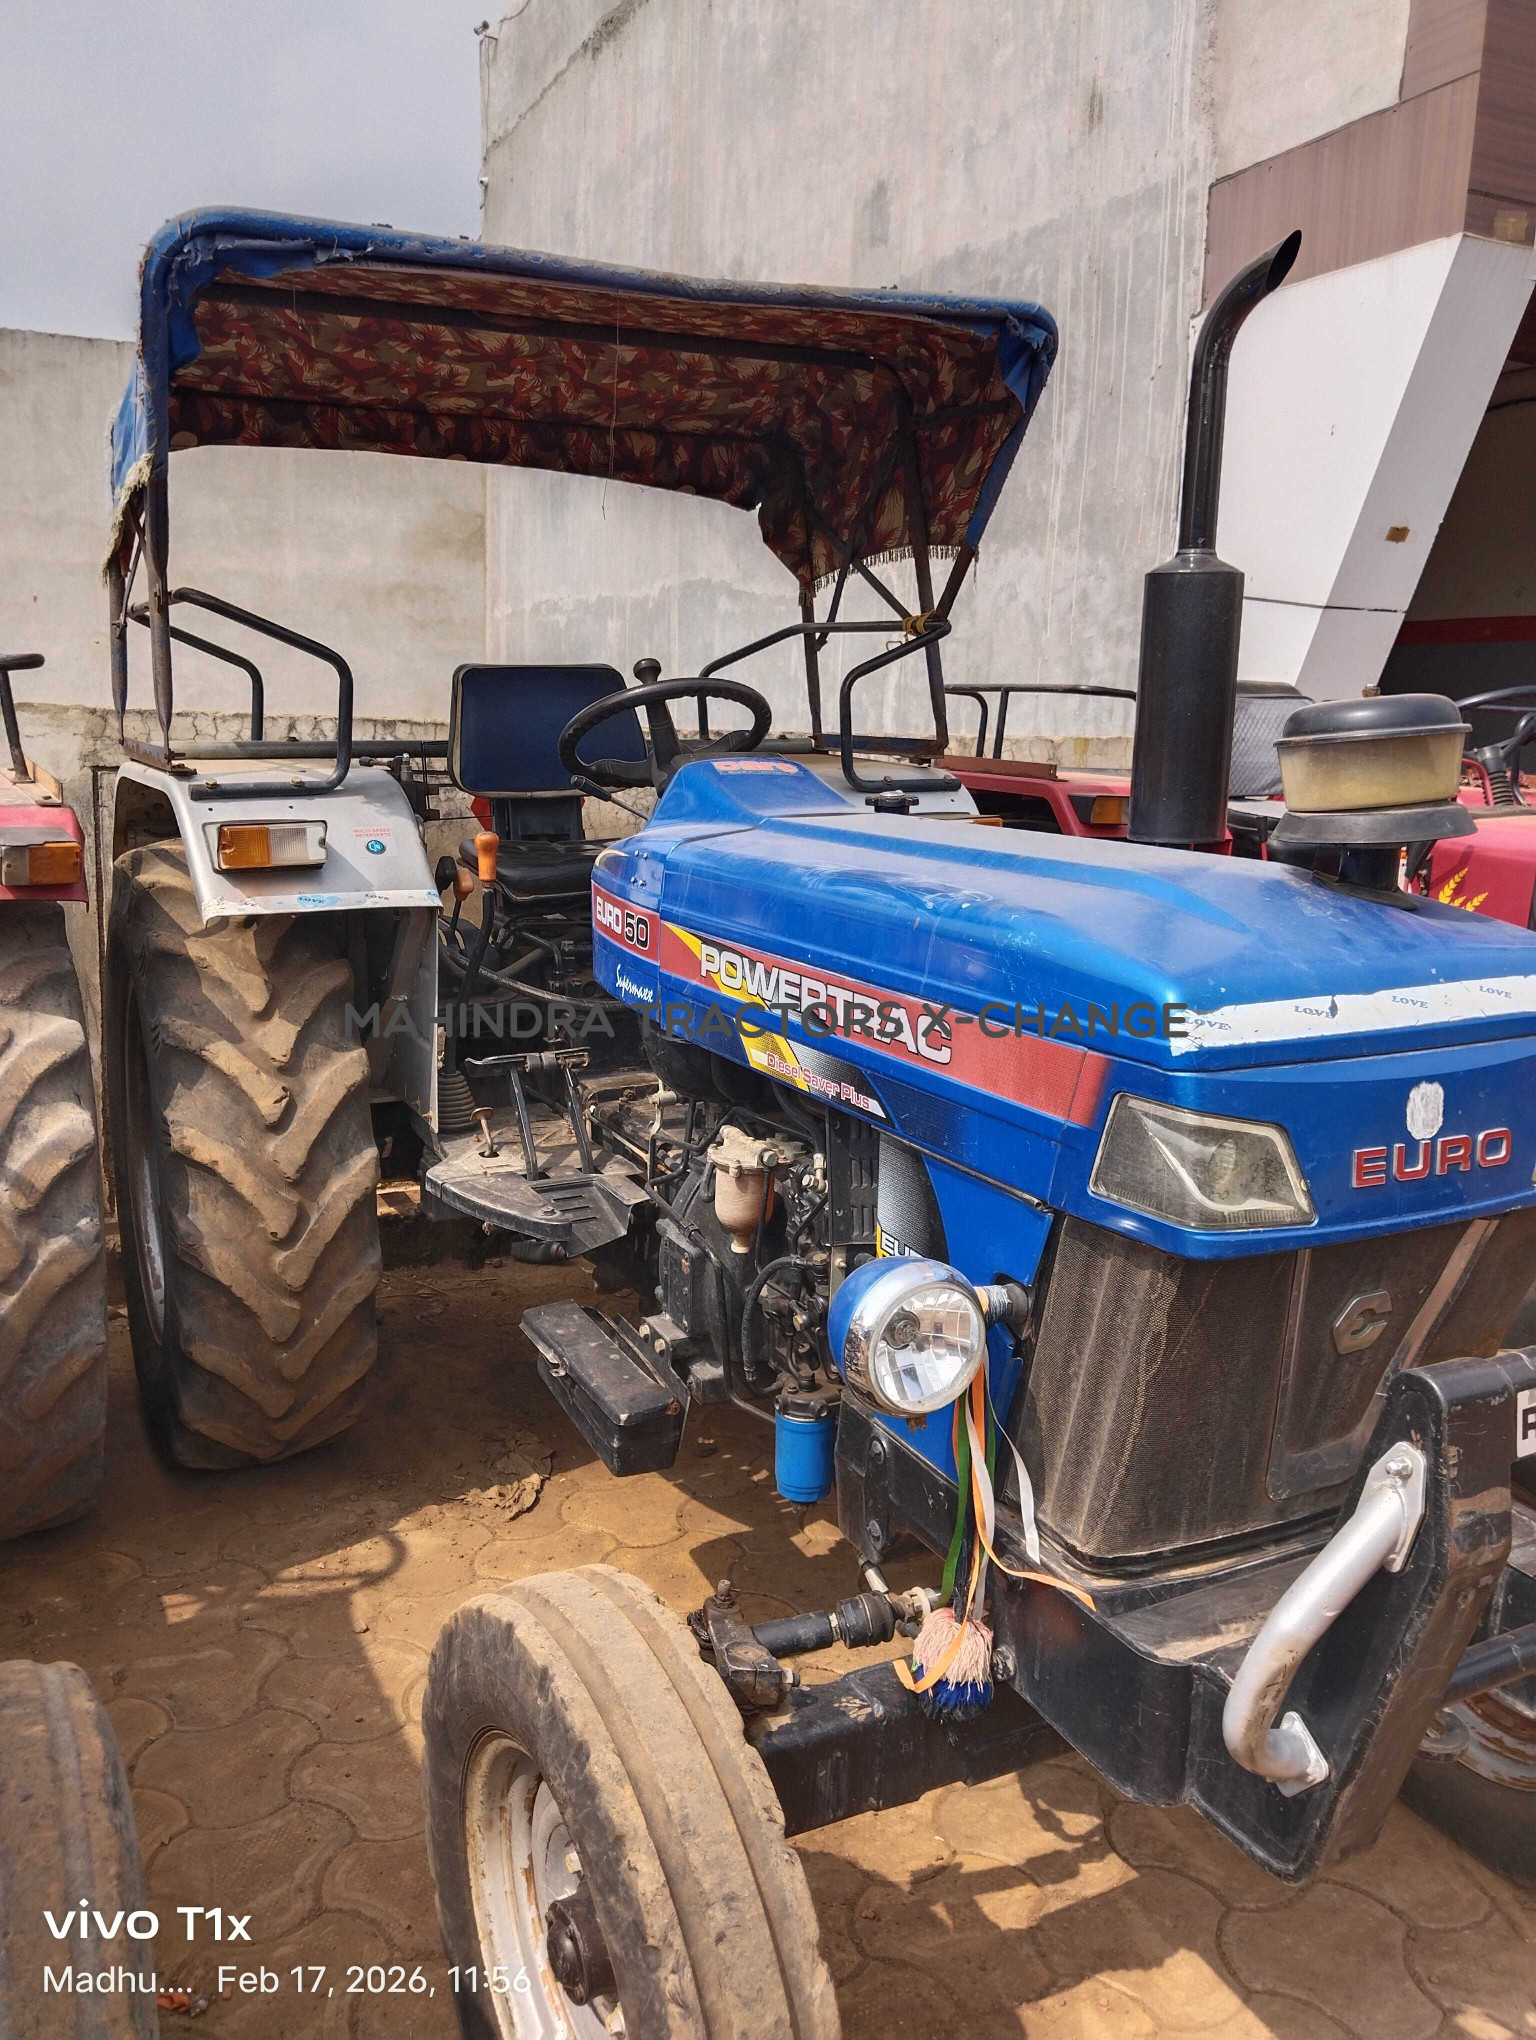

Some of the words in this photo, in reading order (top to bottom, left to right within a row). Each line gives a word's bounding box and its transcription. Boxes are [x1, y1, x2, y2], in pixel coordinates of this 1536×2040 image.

[596, 895, 622, 935] EURO
[624, 909, 650, 951] 50
[700, 943, 952, 1064] POWERTRAC
[1391, 995, 1428, 1009] LOVE
[1479, 985, 1512, 999] LOVE
[767, 1052, 800, 1080] Diesel
[802, 1069, 839, 1096] Saver
[841, 1082, 870, 1110] Plus
[1352, 1127, 1513, 1188] EURO
